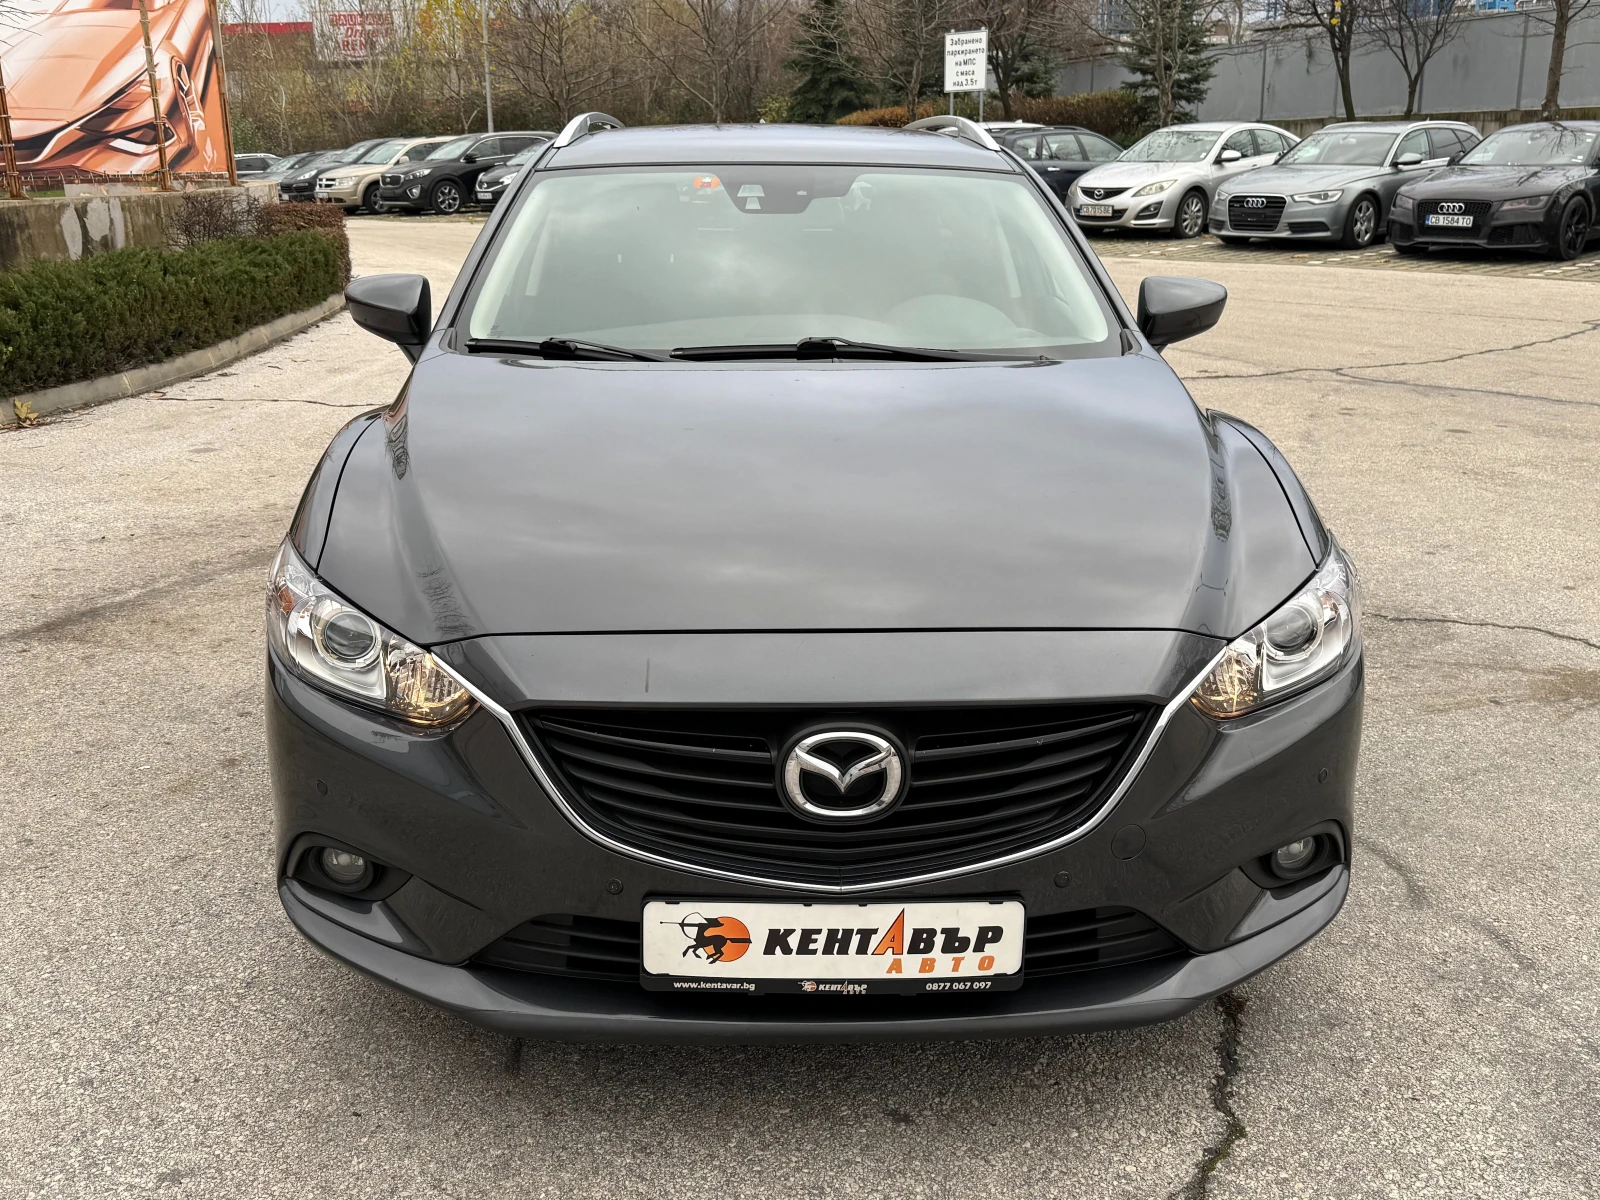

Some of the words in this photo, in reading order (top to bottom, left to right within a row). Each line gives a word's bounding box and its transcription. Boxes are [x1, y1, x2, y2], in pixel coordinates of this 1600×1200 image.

[950, 38, 982, 46] Забранено
[947, 48, 985, 57] паркирането
[963, 58, 976, 66] МПС
[1430, 216, 1440, 224] CB
[1442, 216, 1460, 224] 1584
[762, 907, 1004, 956] КЕНТАВЪР
[886, 954, 996, 974] АВТО
[673, 981, 756, 991] www.kentavar.bg
[925, 982, 951, 991] 0877
[952, 981, 972, 990] 067
[972, 981, 992, 989] 097
